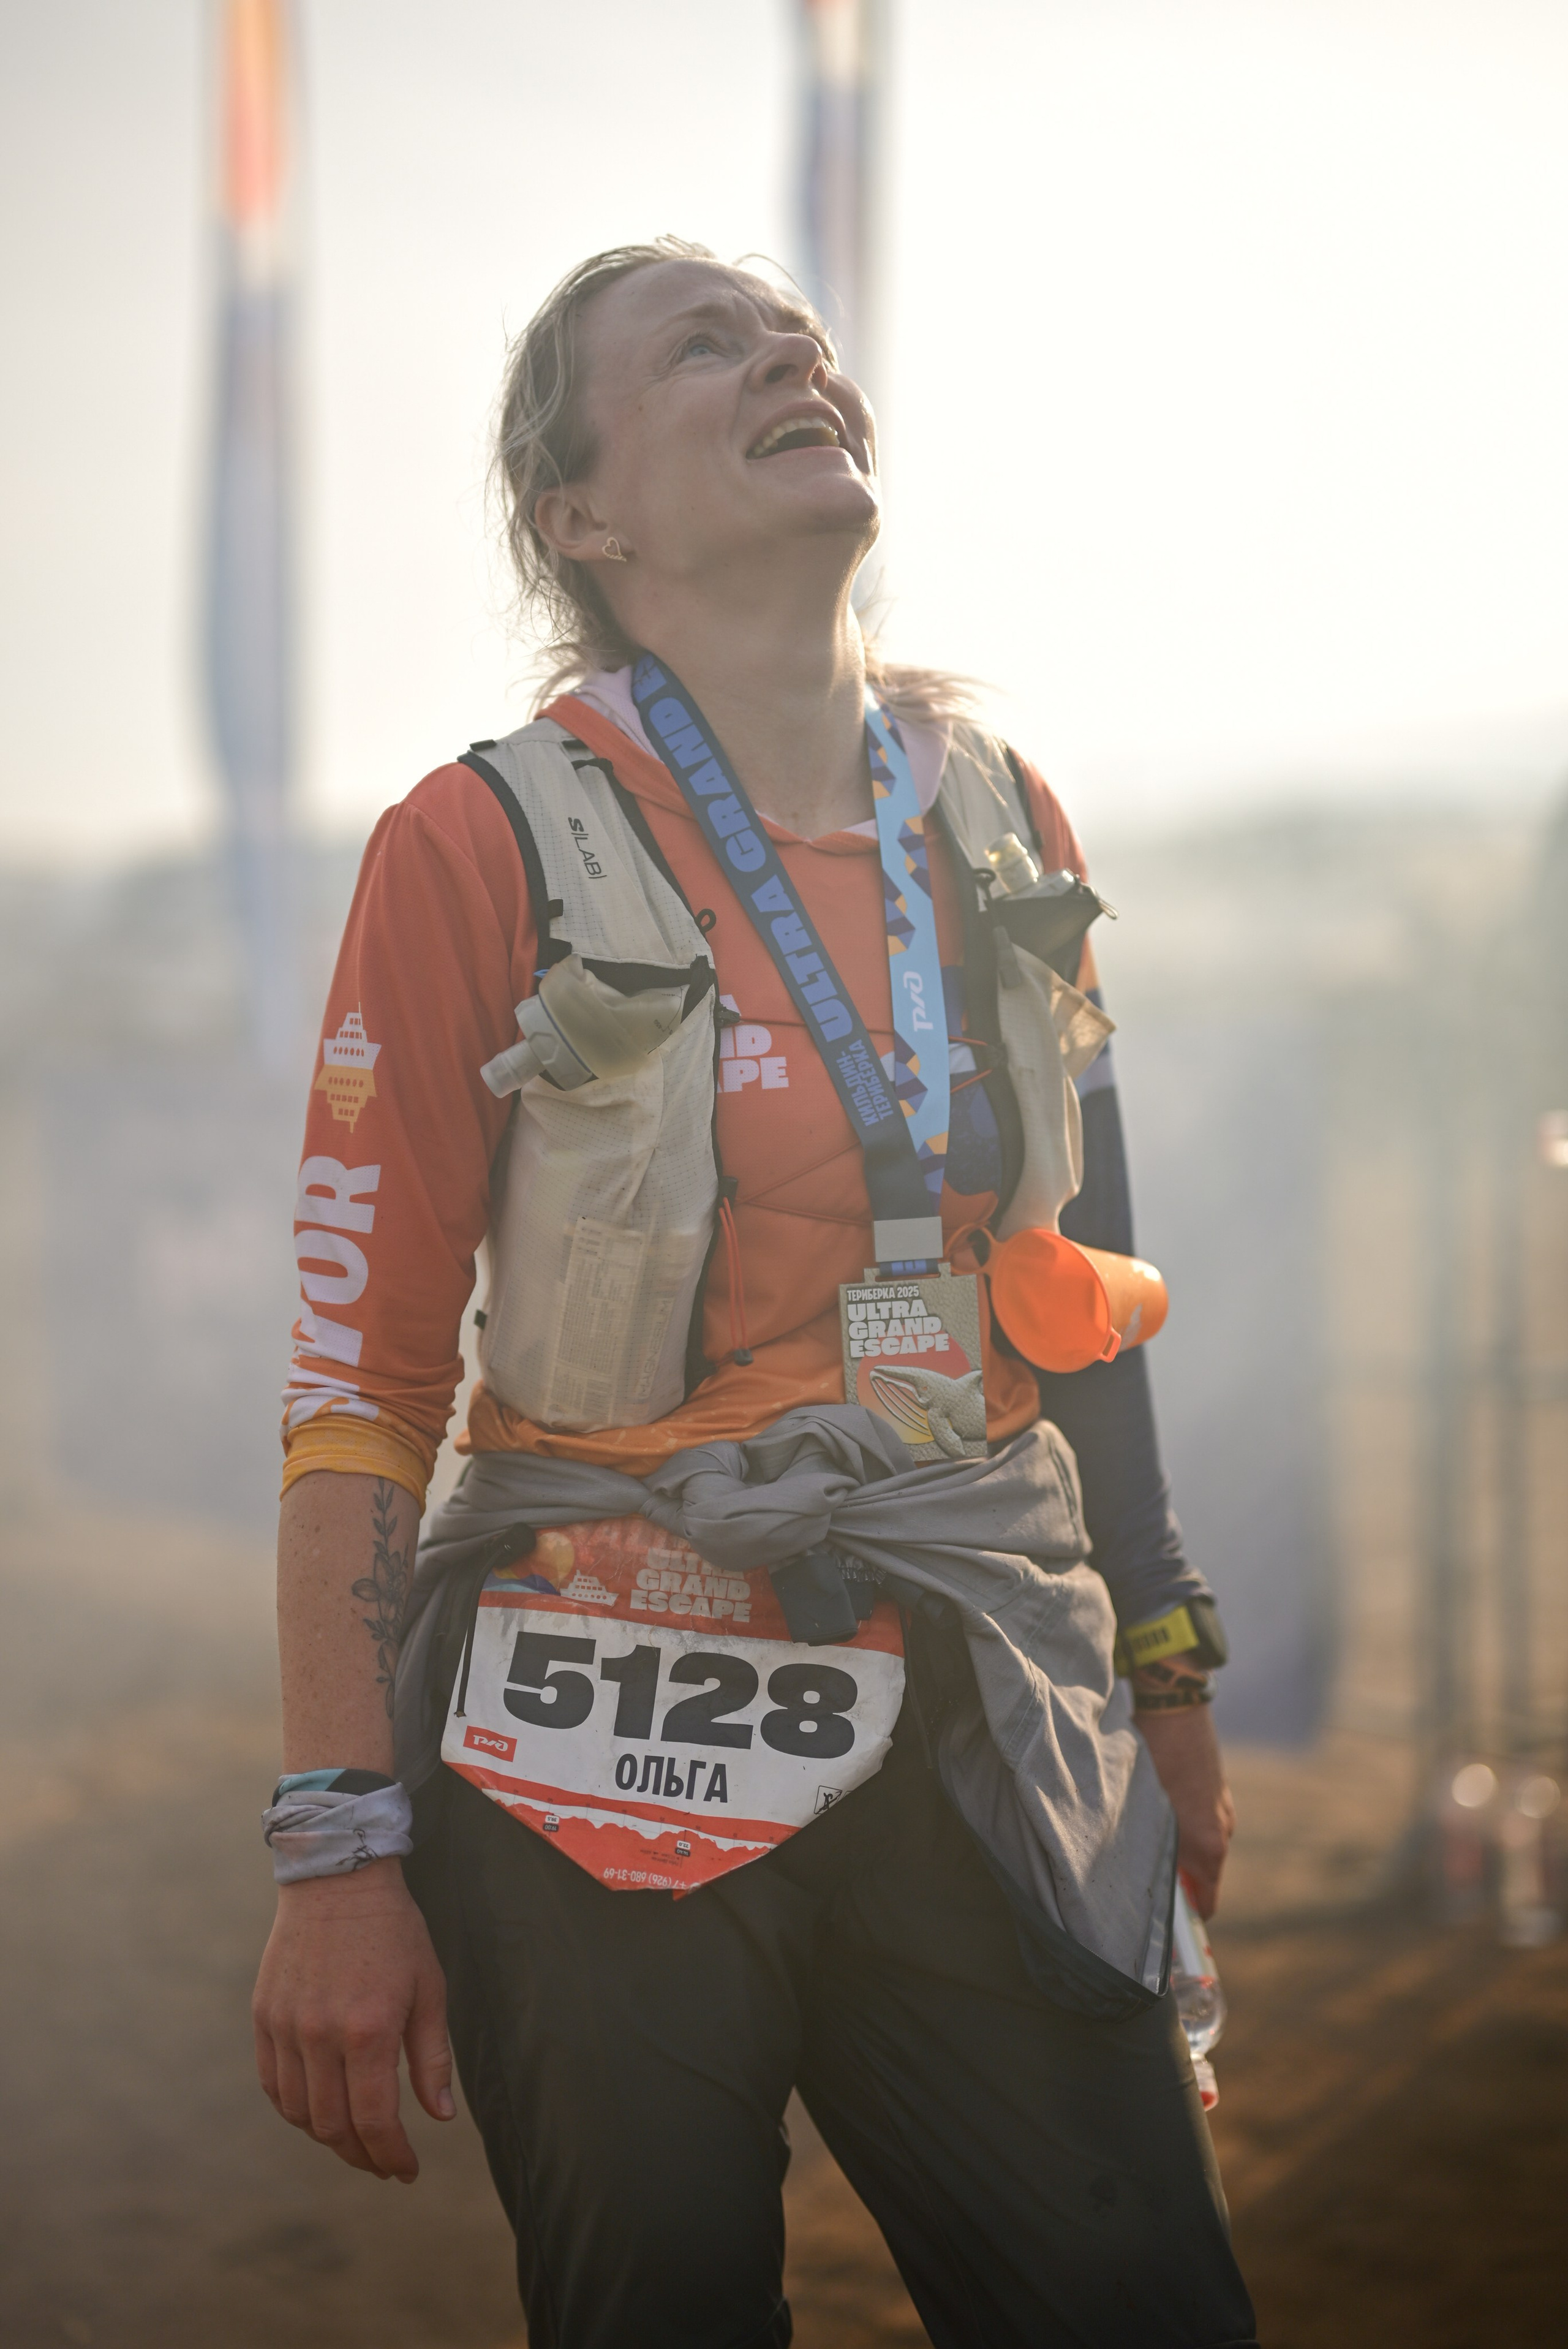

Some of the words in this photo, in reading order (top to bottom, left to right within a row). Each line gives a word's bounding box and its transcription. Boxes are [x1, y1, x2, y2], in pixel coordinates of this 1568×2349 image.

[649, 697, 766, 872] GRAND
[751, 874, 853, 1042] ULTRA
[717, 1056, 789, 1093] PE
[836, 1051, 880, 1126] КИЛЬДИН-
[849, 1039, 894, 1120] ТЕРИБЕРКА
[847, 1287, 895, 1301] ТЕРИБЕРКА
[897, 1285, 919, 1298] 2025
[848, 1299, 929, 1322] ULTRA
[848, 1317, 942, 1340] GRAND
[850, 1333, 950, 1358] ESCAPE
[636, 1568, 751, 1602] GRAND
[630, 1589, 752, 1623] ESCAPE
[503, 1631, 858, 1759] 5128
[615, 1753, 728, 1803] ОЛЬГА
[603, 1867, 647, 1882] 680-31-69
[648, 1873, 672, 1888] (926)
[673, 1880, 687, 1889] +7
